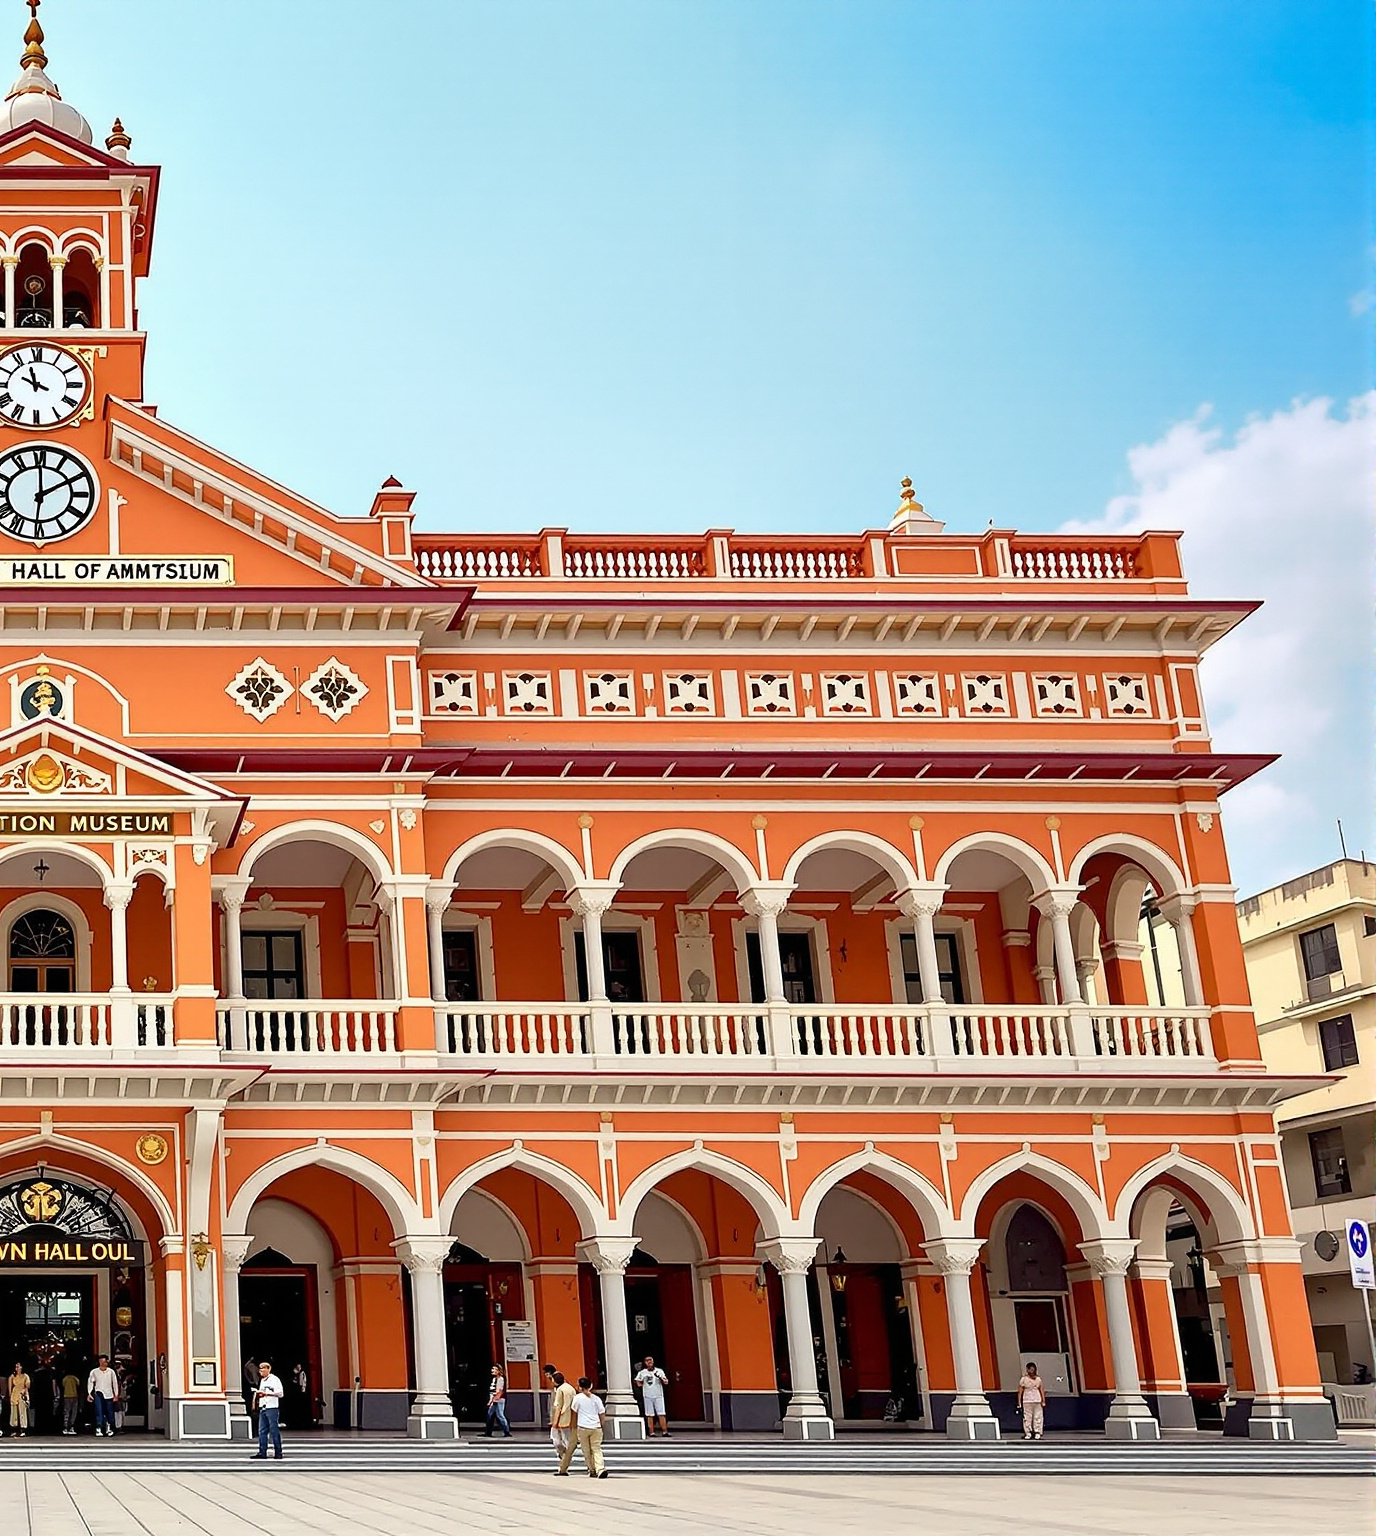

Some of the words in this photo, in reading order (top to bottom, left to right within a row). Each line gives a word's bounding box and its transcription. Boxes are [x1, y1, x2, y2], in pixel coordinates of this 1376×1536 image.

[12, 563, 66, 579] HALL
[74, 563, 101, 579] OF
[70, 815, 168, 831] MUSEUM
[35, 1242, 89, 1261] HALL
[91, 1242, 136, 1260] OUL
